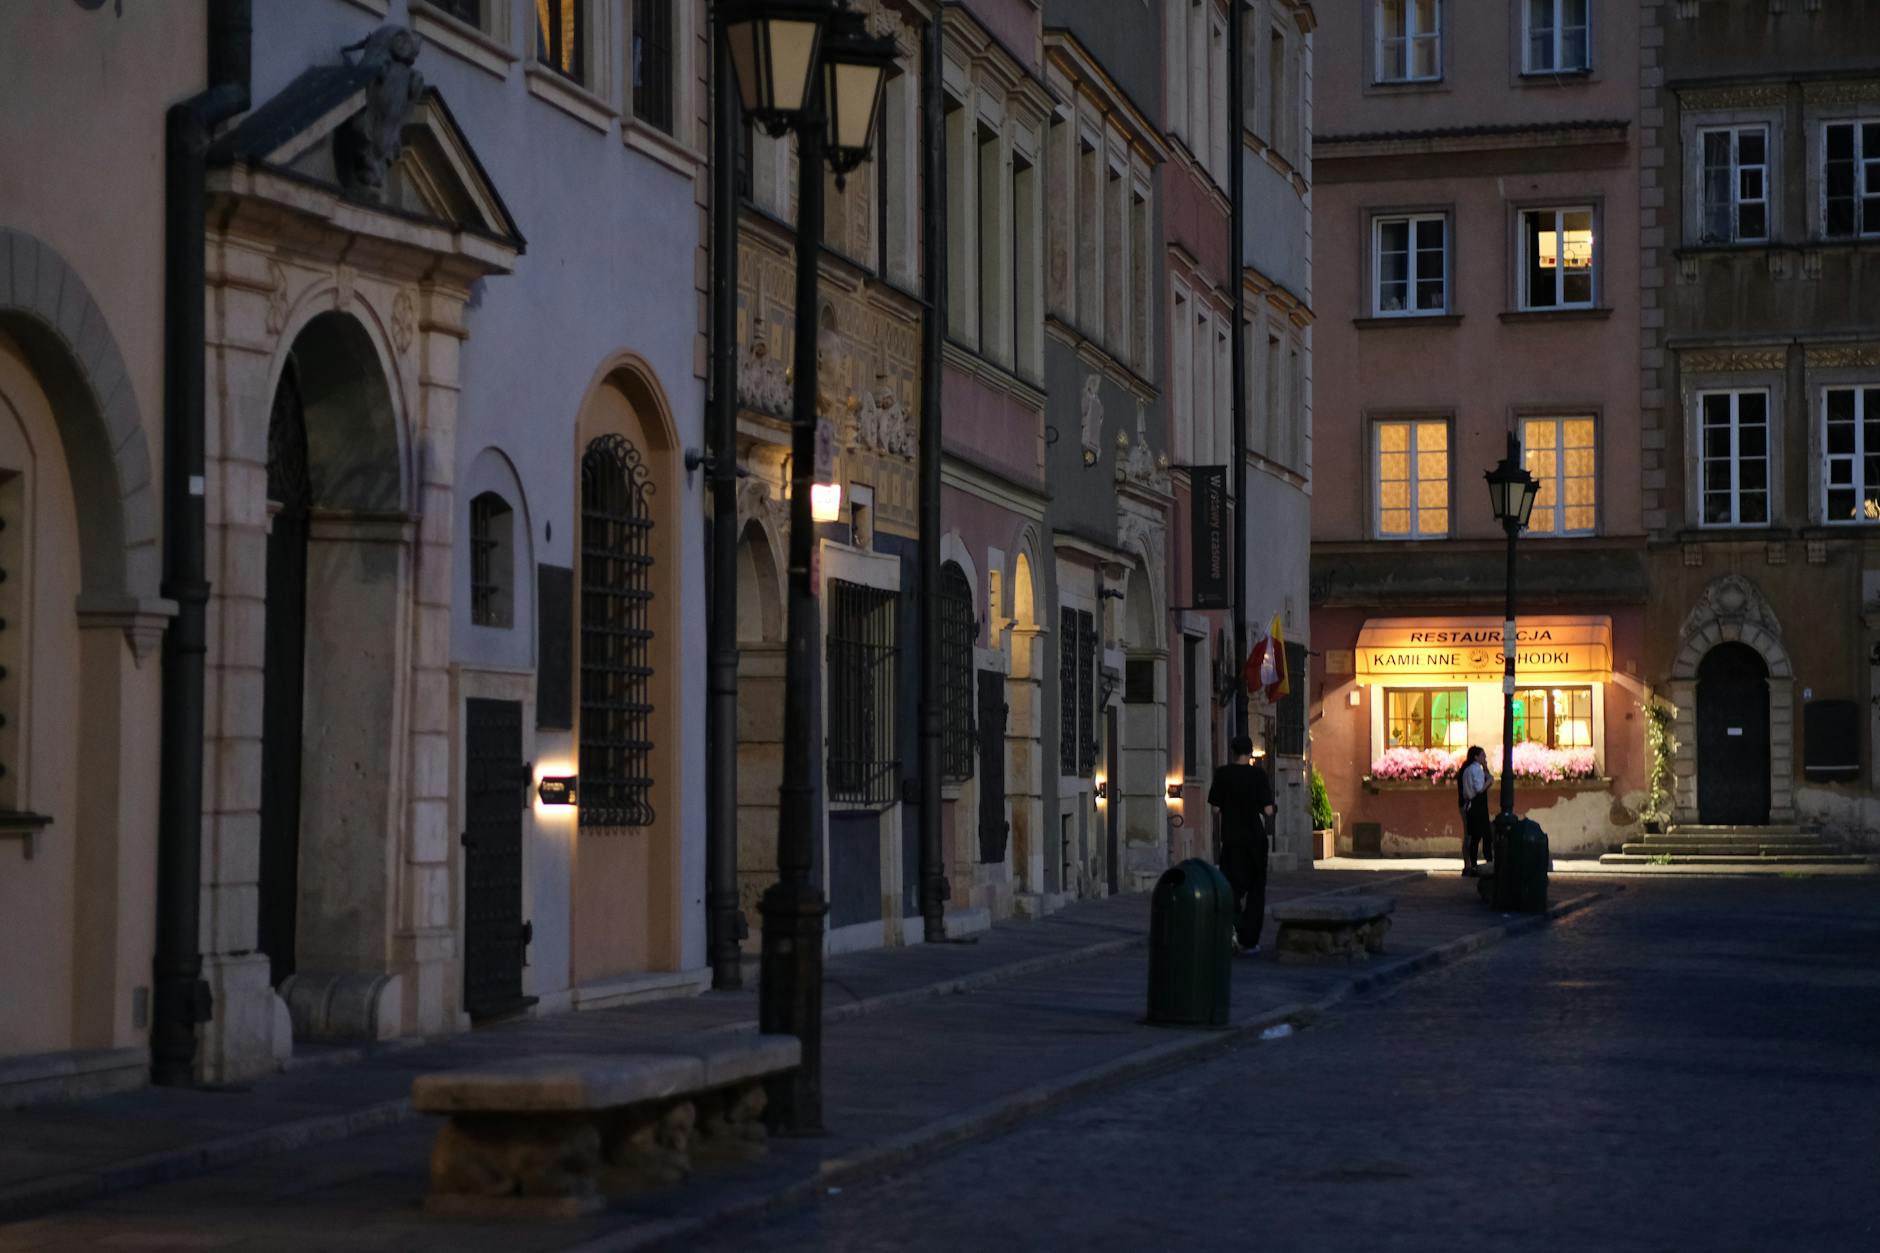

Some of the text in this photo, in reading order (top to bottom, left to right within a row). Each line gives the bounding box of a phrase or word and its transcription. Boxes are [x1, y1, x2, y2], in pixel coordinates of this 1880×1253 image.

[1410, 630, 1552, 643] RESTAURCJA
[1374, 652, 1570, 666] KAMIENNE SHODKI
